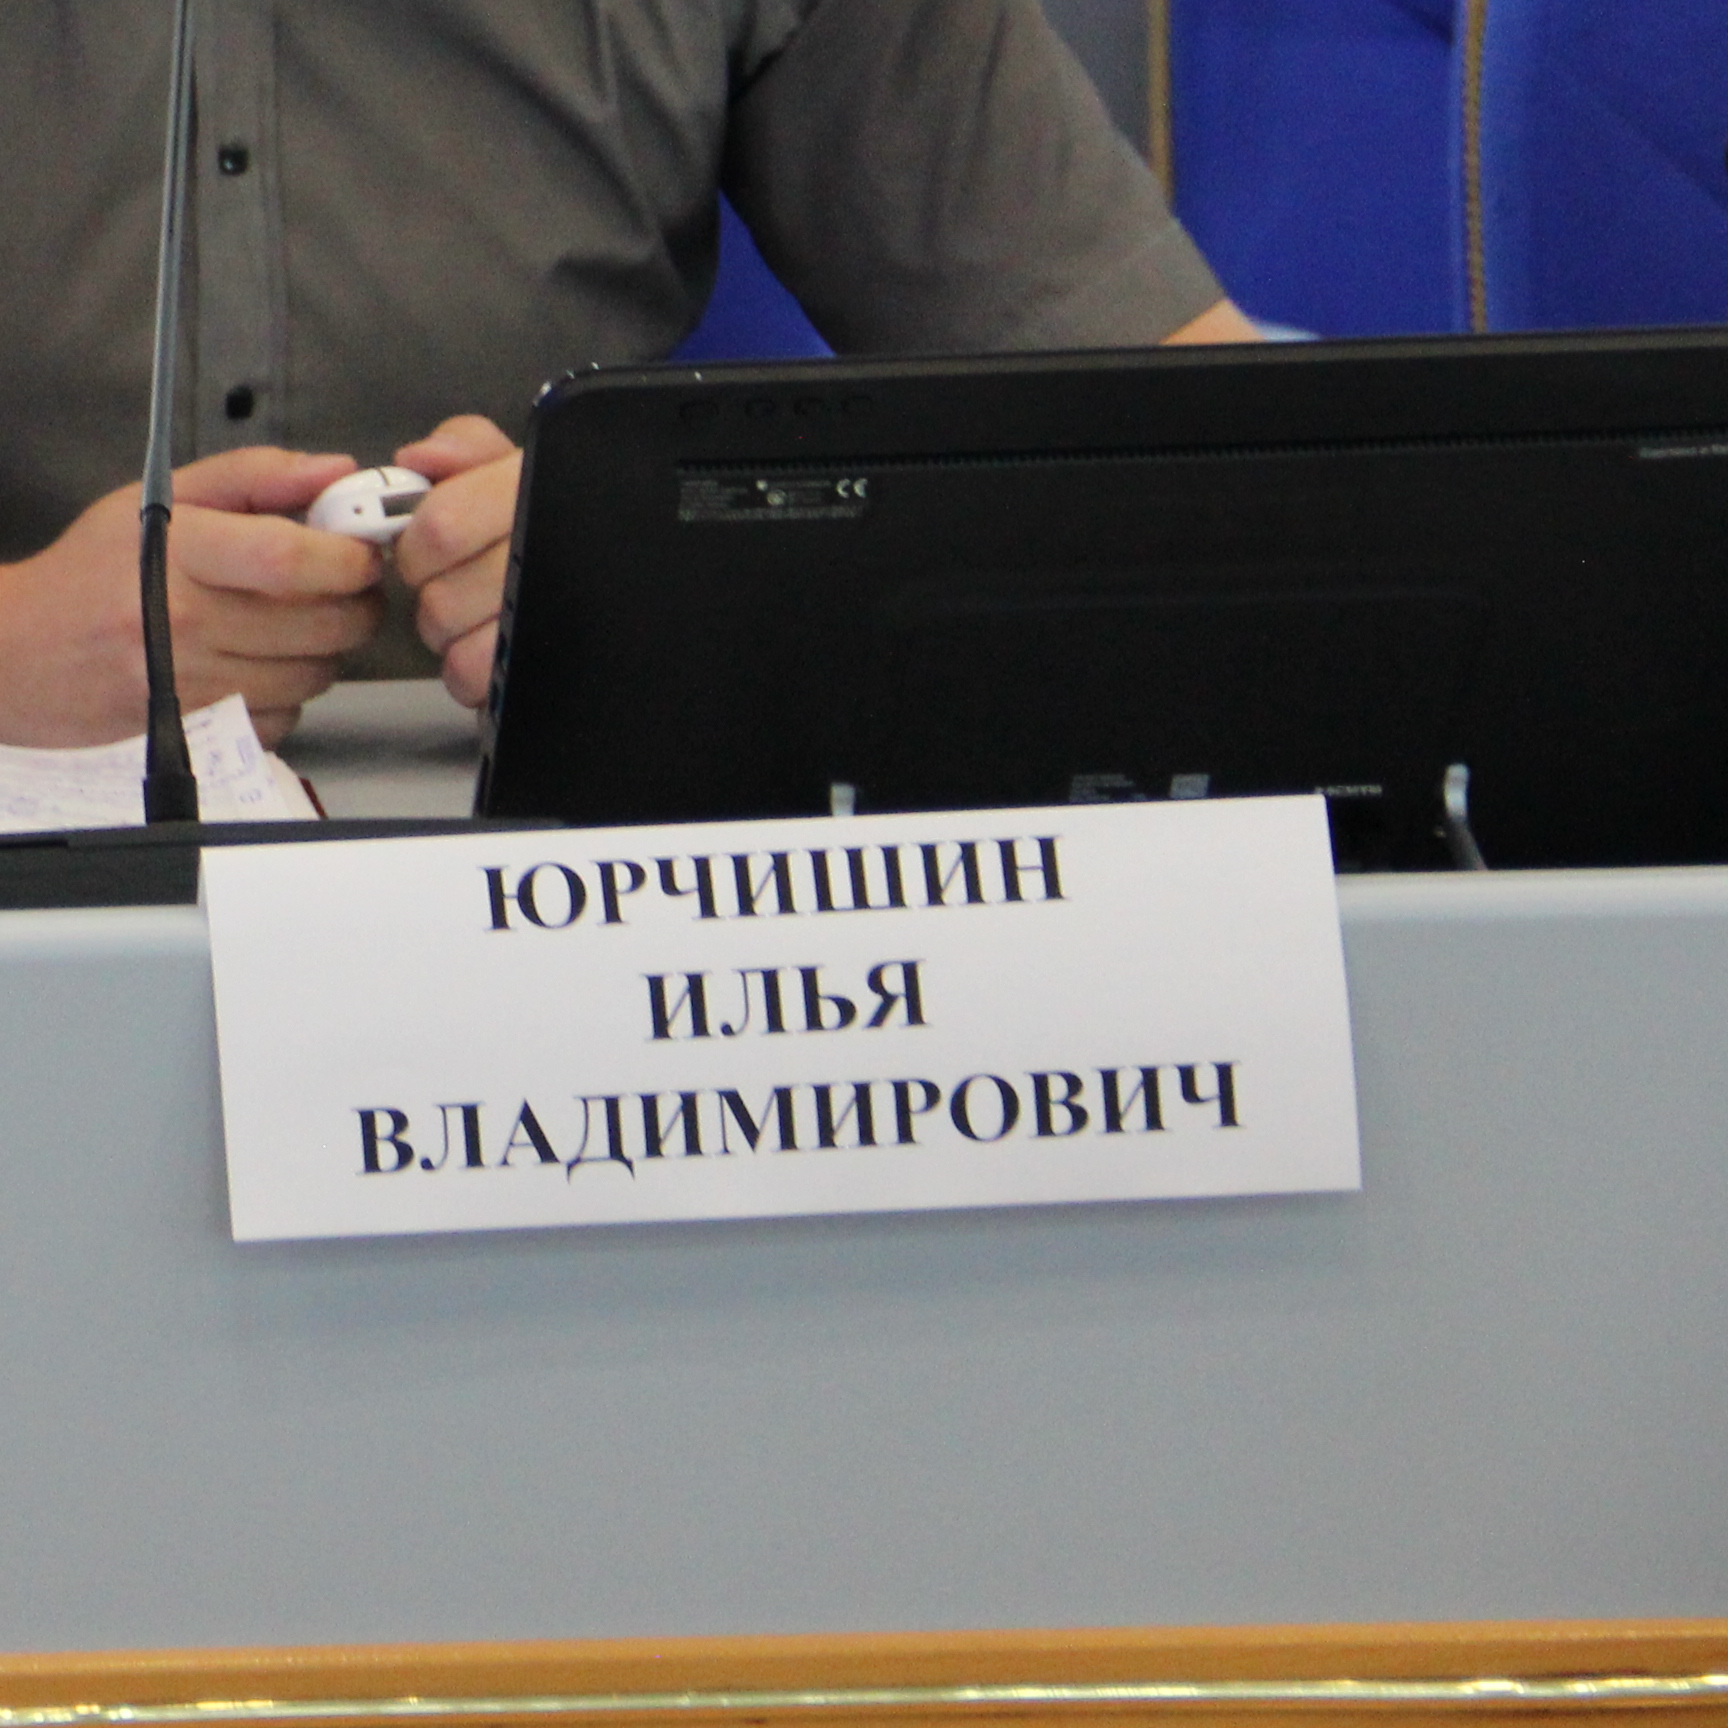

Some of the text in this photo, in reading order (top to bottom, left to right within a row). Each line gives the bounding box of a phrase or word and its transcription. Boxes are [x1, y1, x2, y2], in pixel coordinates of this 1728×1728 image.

[482, 835, 1066, 931] ЮРЧИШИН
[641, 959, 928, 1040] ИЛЬЯ
[354, 1060, 1242, 1182] ВЛАДИМИРОВИЧ
